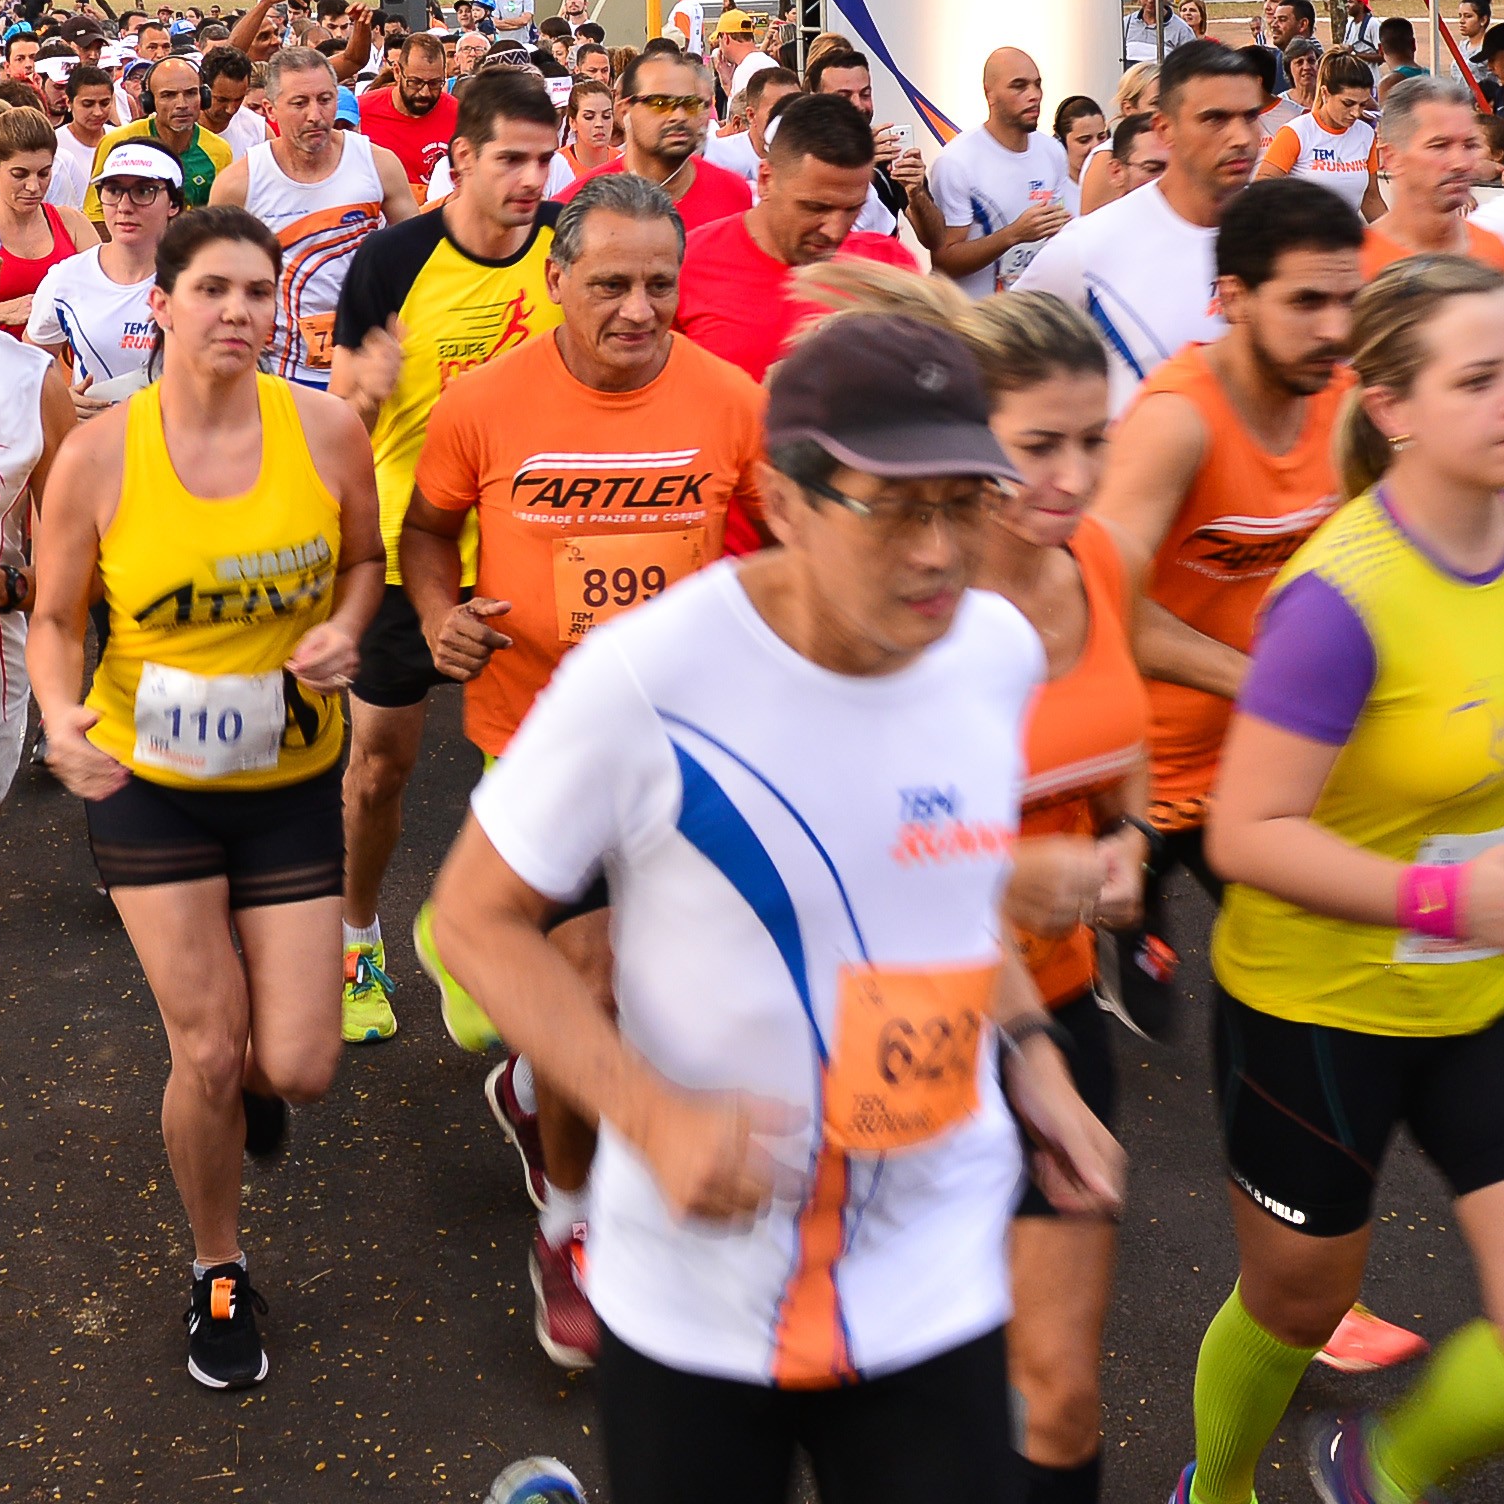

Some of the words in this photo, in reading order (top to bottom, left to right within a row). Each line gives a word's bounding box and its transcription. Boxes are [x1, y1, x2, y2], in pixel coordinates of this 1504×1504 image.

[1312, 148, 1335, 161] TEM
[1309, 158, 1368, 173] RUNNIN
[122, 321, 149, 336] TEM
[511, 469, 713, 509] FARTLEK
[512, 509, 573, 524] LIBERDADE
[576, 514, 585, 524] E
[589, 512, 636, 524] PRAZER
[640, 512, 658, 523] EM
[582, 565, 667, 608] 899
[570, 611, 594, 623] TEM
[162, 704, 244, 745] 110
[1264, 1195, 1306, 1225] FIELD
